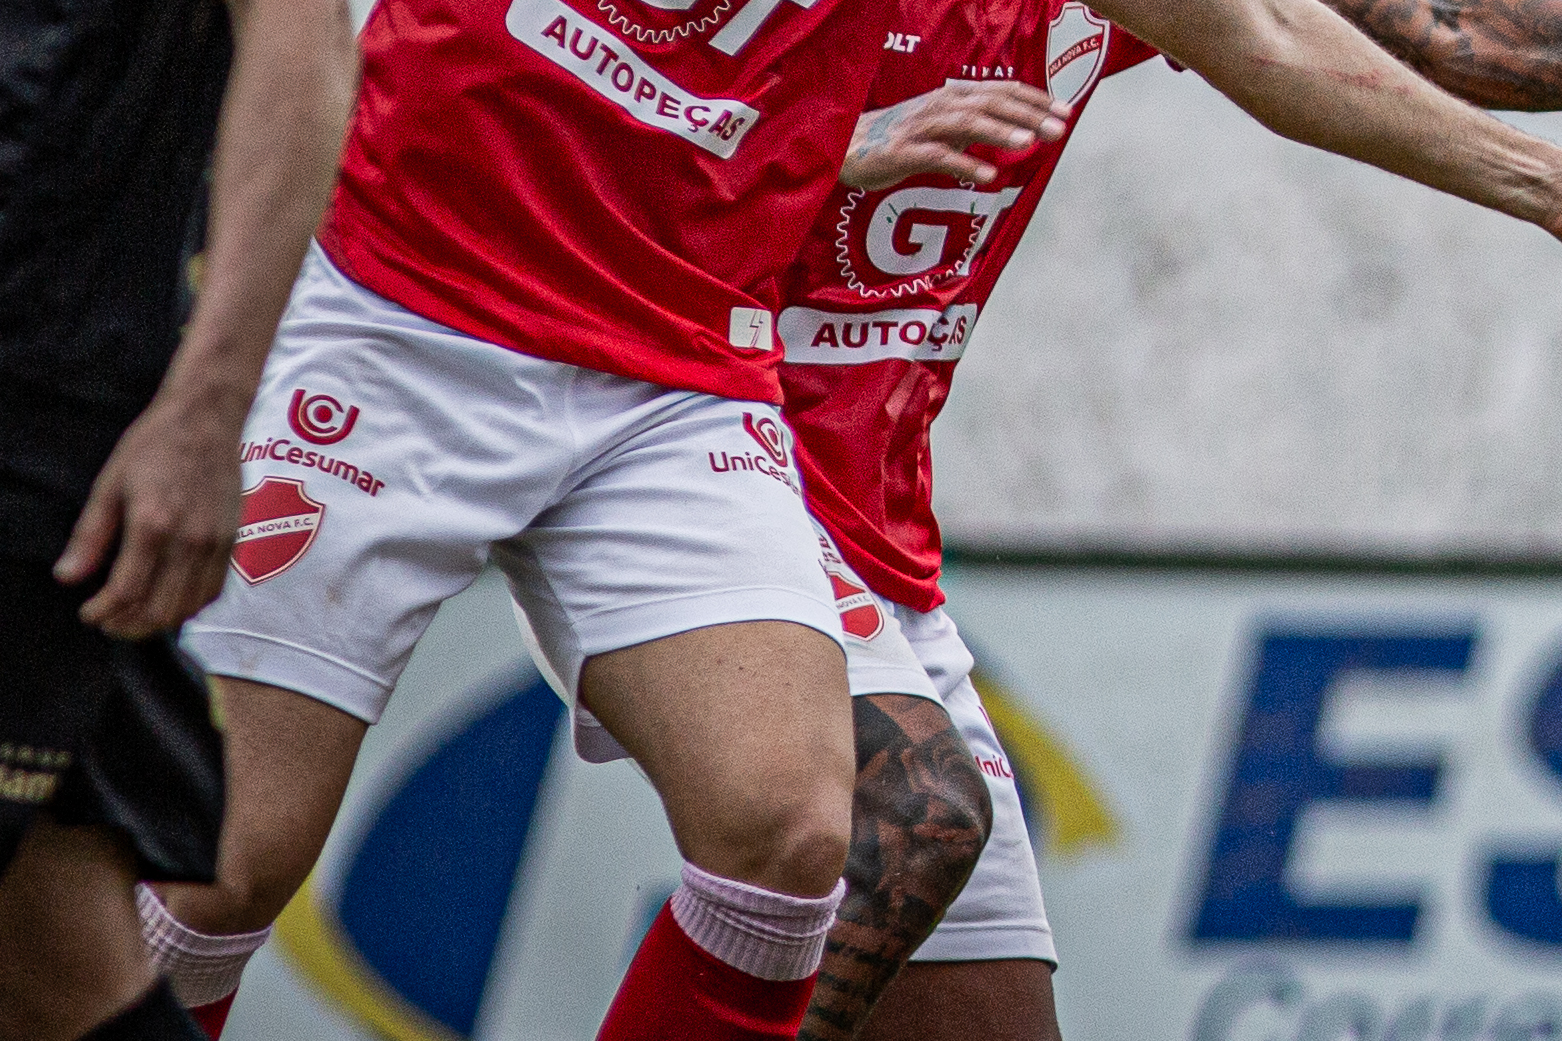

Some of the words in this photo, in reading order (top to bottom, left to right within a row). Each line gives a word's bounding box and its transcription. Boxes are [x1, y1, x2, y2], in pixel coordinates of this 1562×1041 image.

[540, 14, 746, 141] AUTOPEÇAS
[865, 186, 1024, 277] GT
[237, 528, 255, 540] ILA
[257, 520, 291, 534] NOVA
